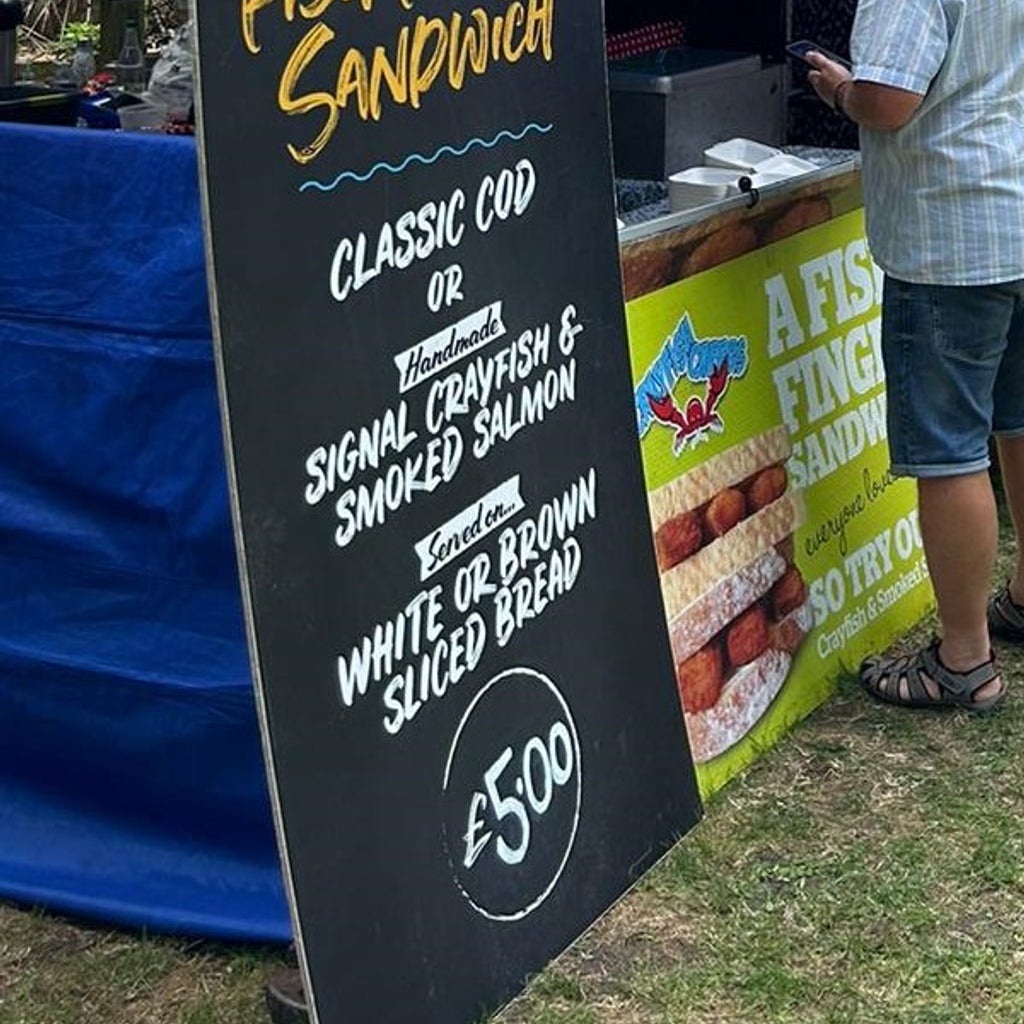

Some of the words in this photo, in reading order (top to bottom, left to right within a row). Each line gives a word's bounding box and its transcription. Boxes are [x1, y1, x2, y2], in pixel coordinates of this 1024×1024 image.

[329, 188, 465, 301] CLASSIC
[475, 158, 536, 232] COD
[426, 265, 463, 311] OR
[765, 273, 804, 359] A
[404, 307, 500, 386] Handmade
[304, 401, 416, 505] SIGNAL
[425, 323, 550, 434] CRAYFISH
[558, 304, 583, 356] &
[334, 427, 463, 547] SMOKED
[473, 360, 575, 459] SALMON
[428, 502, 483, 571] Served
[804, 494, 865, 556] everyone
[338, 585, 444, 706] WHITE
[454, 553, 496, 612] OR
[499, 468, 595, 585] BROWN
[808, 568, 845, 627] SO
[845, 527, 893, 597] TRY
[817, 607, 866, 659] Crayfish
[876, 561, 922, 611] Smoked
[383, 612, 486, 734] SLICED
[494, 537, 581, 646] BREAD
